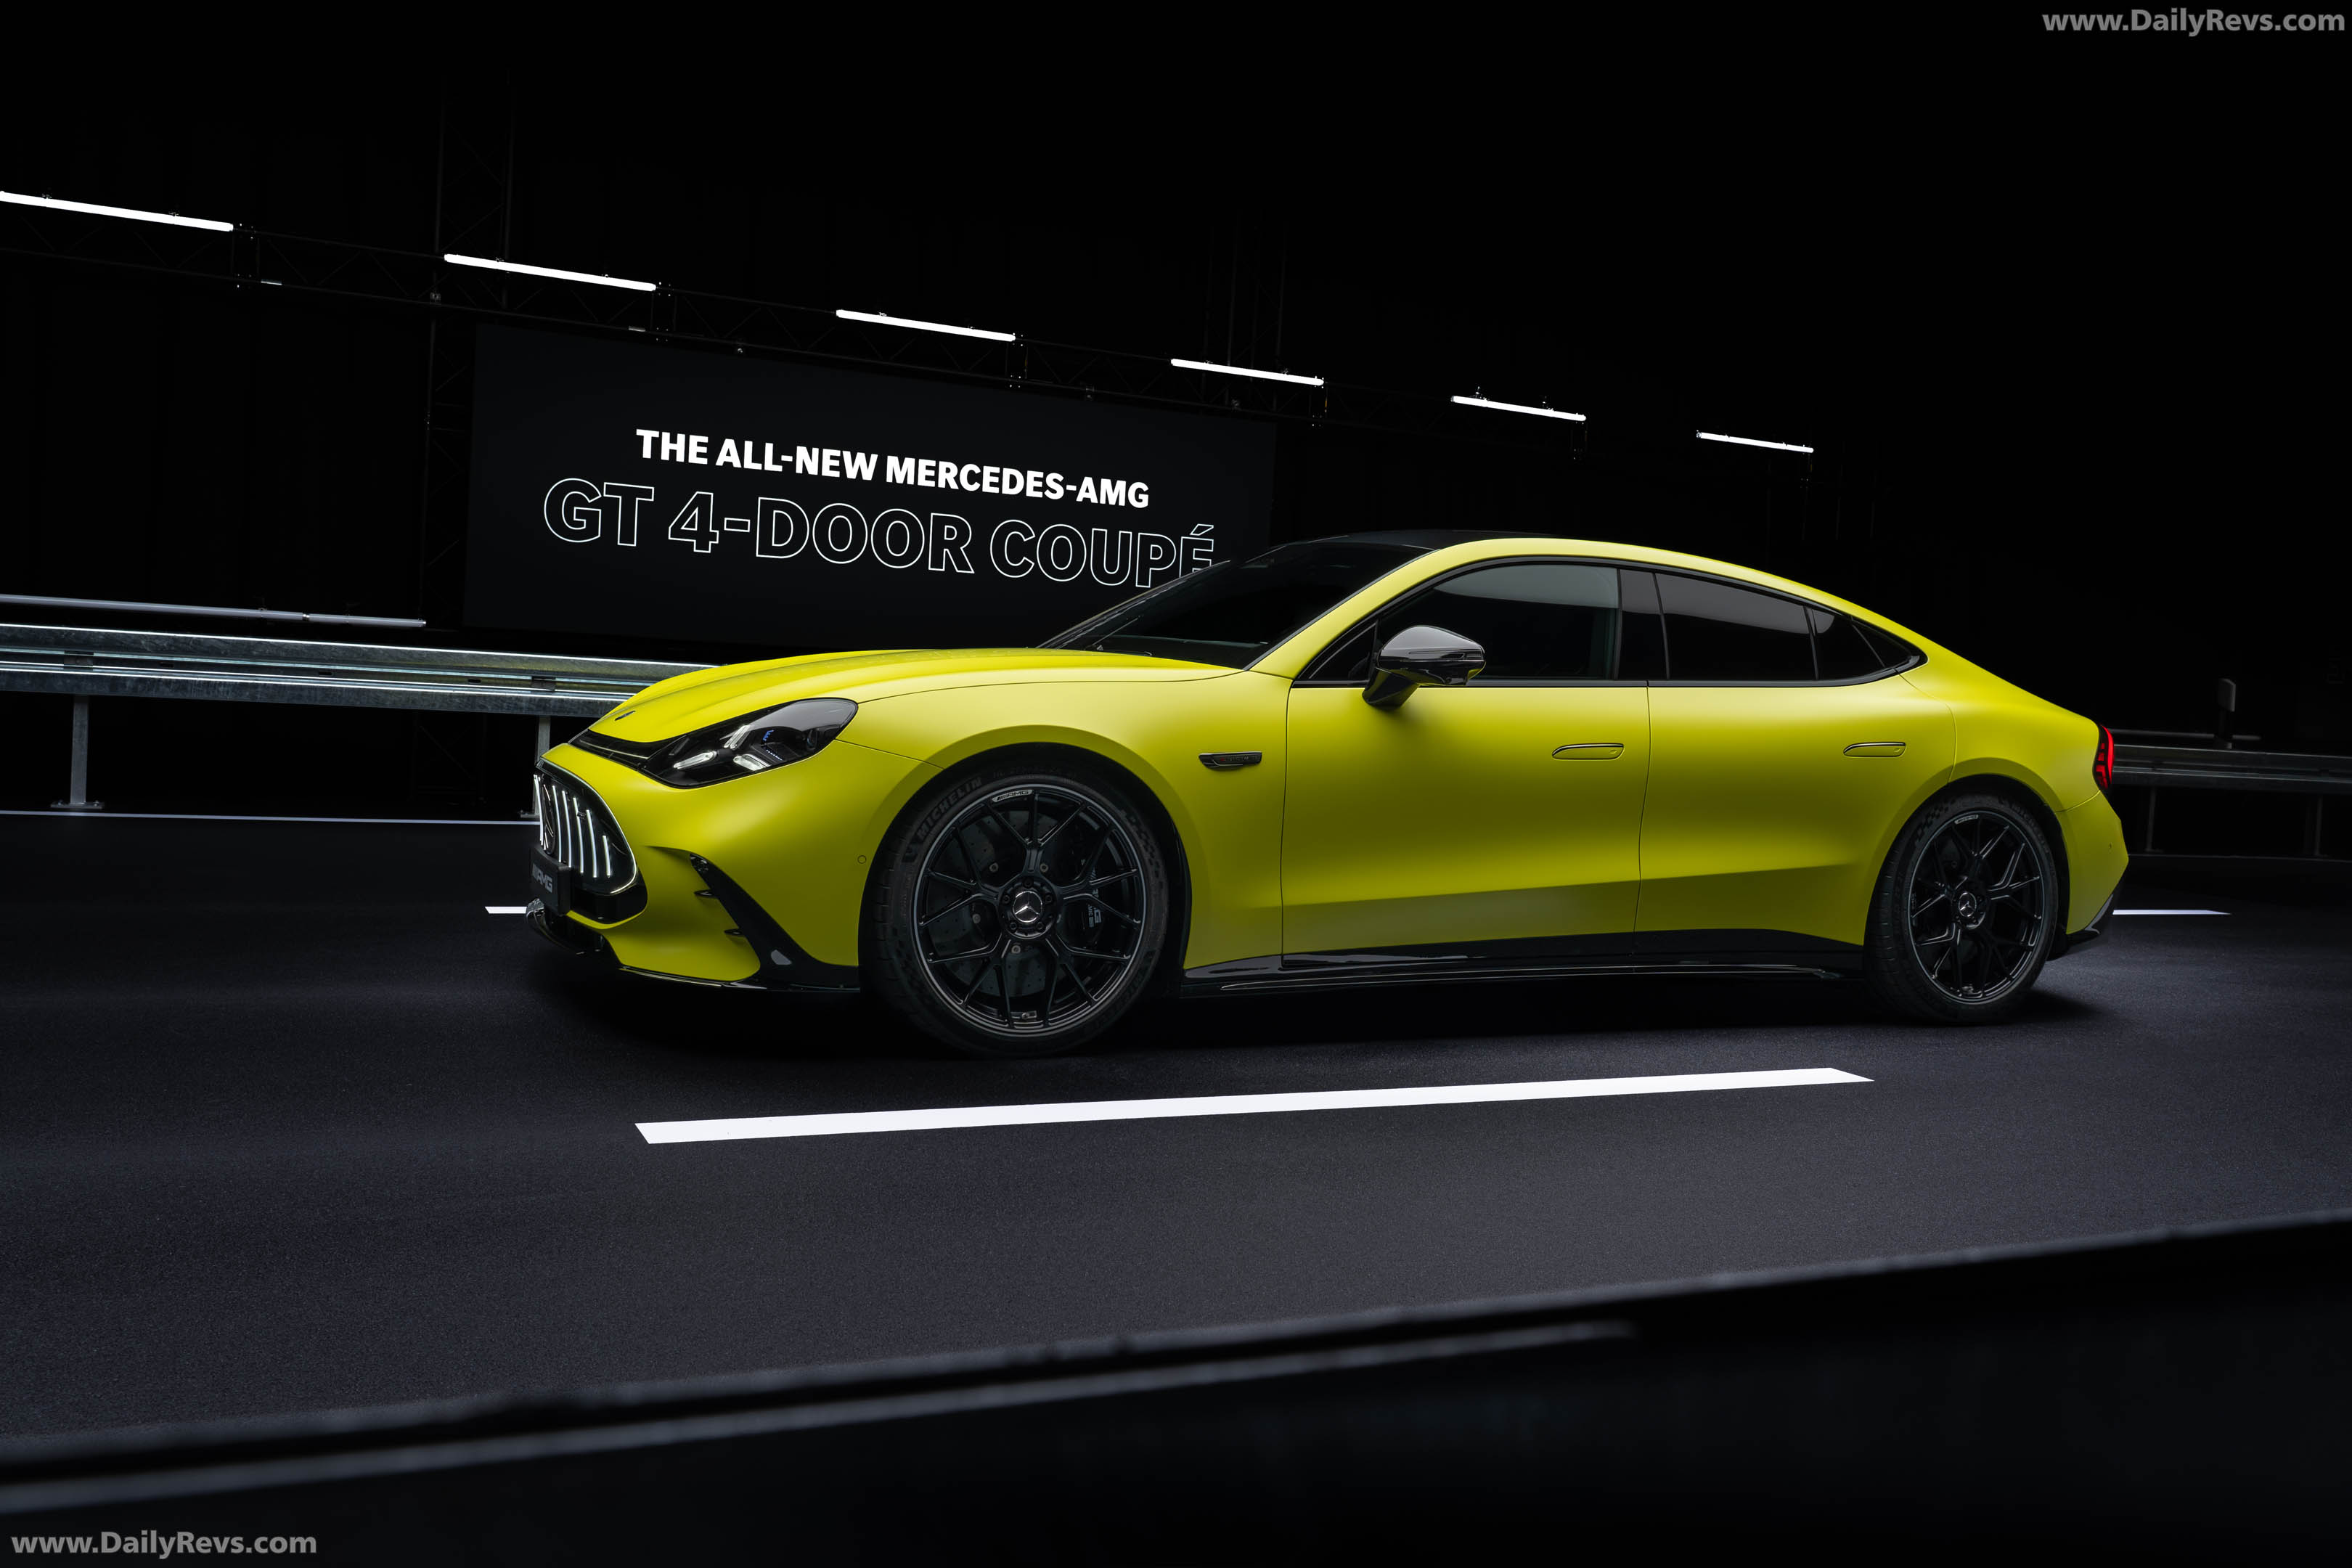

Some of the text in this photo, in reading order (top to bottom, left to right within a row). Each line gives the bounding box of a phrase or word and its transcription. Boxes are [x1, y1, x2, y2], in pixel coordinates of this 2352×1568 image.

[636, 428, 1149, 509] THE ALL-NEW MERCEDES-AMG
[544, 478, 1214, 589] GT 4-DOOR COUPÉ
[915, 774, 982, 840] MICHELIN
